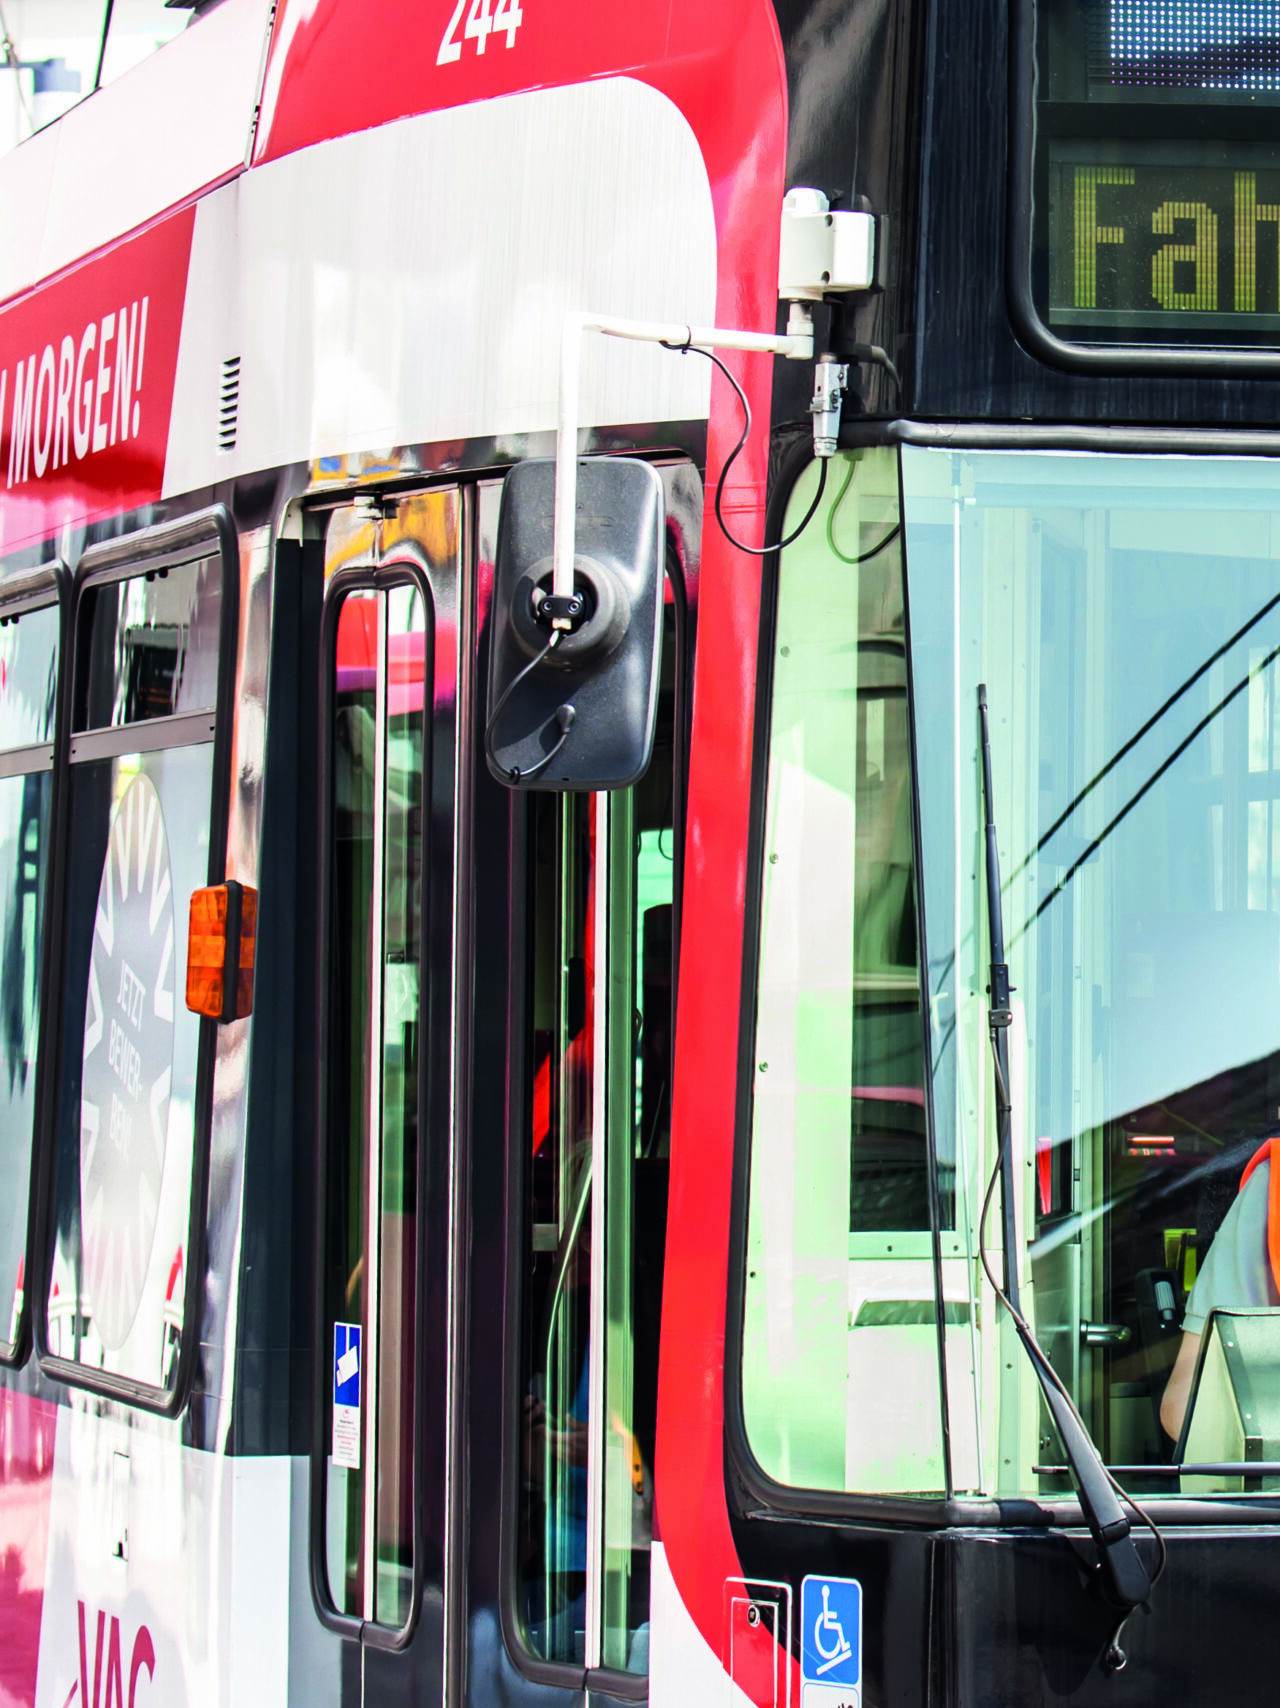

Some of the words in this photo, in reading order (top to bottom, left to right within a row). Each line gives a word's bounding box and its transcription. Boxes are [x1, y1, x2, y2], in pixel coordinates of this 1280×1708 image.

[436, 0, 523, 66] 244
[7, 296, 149, 489] MORGEN!
[117, 960, 146, 1032] JETZT
